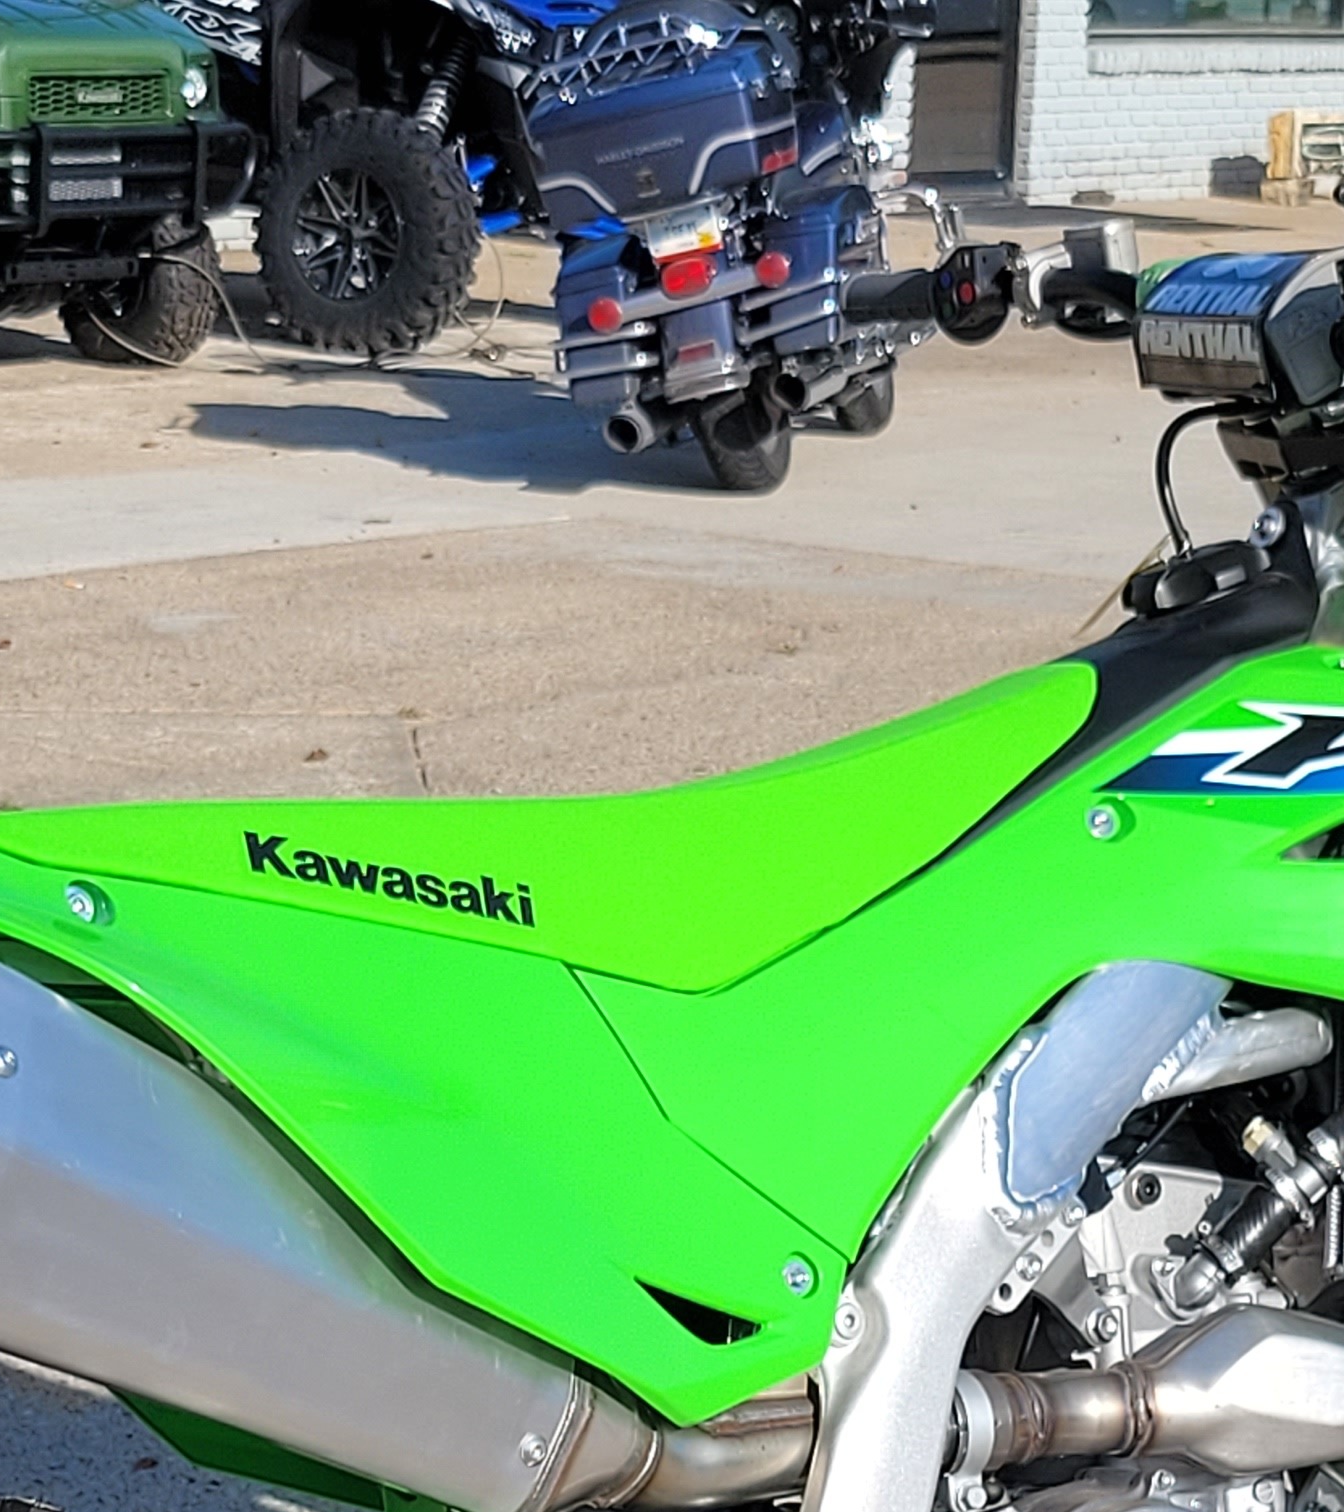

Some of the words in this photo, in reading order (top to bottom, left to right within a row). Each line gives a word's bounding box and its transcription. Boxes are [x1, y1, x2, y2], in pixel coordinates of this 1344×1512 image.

[1144, 283, 1273, 316] RENTHAL
[1139, 319, 1261, 363] RENTHAL
[243, 830, 536, 929] Kawasaki
